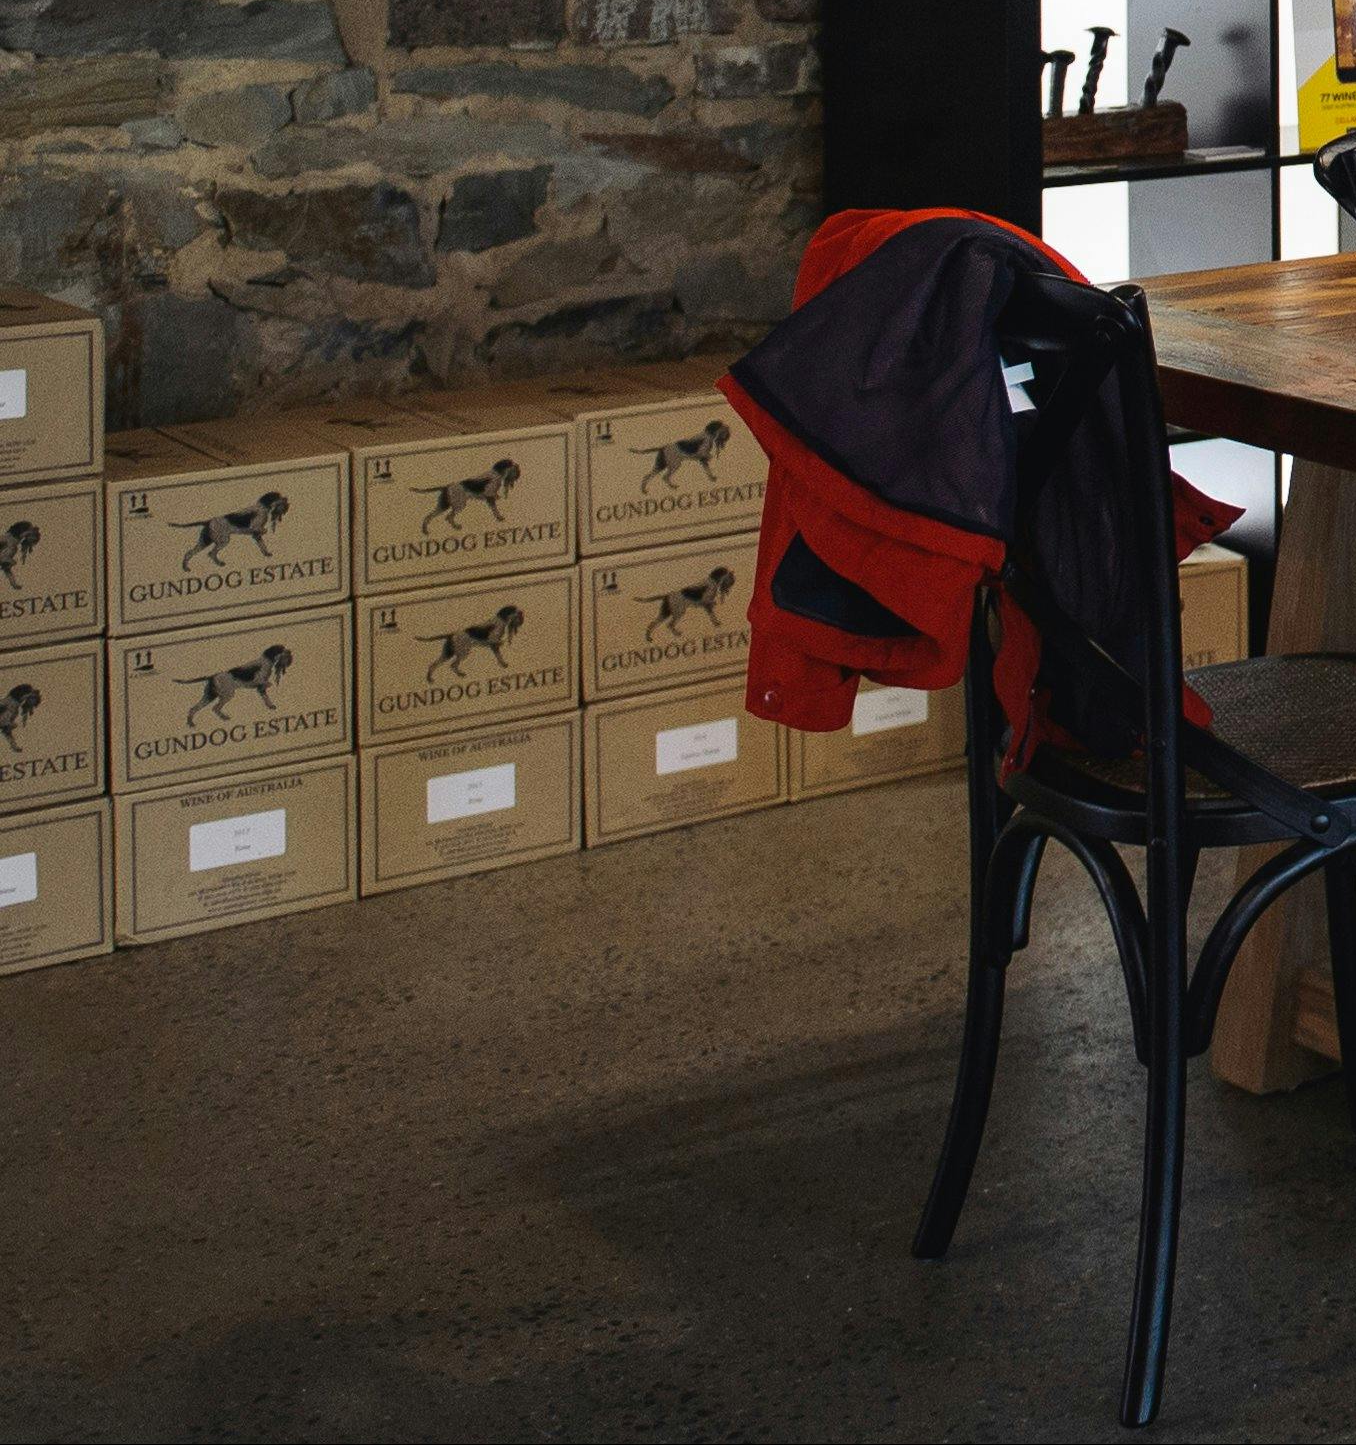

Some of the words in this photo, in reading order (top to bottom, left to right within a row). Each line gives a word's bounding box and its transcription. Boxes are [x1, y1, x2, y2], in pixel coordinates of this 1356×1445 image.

[596, 493, 693, 523] GUNDOG
[372, 533, 477, 564] GUNDOG
[483, 521, 561, 549] ESTATE
[129, 570, 242, 603] GUNDOG
[250, 556, 334, 585] ESTATE
[0, 590, 88, 619] ESTATE
[602, 642, 698, 672] GUNDOG
[703, 631, 749, 653] ESTA
[379, 679, 481, 714] GUNDOG
[488, 666, 565, 696] ESTATE
[134, 725, 247, 760] GUNDOG
[254, 707, 338, 739] ESTATE
[0, 752, 88, 783] ESTATE
[180, 794, 215, 808] WINE
[215, 790, 231, 803] OF
[236, 777, 304, 799] AUSTRALIA
